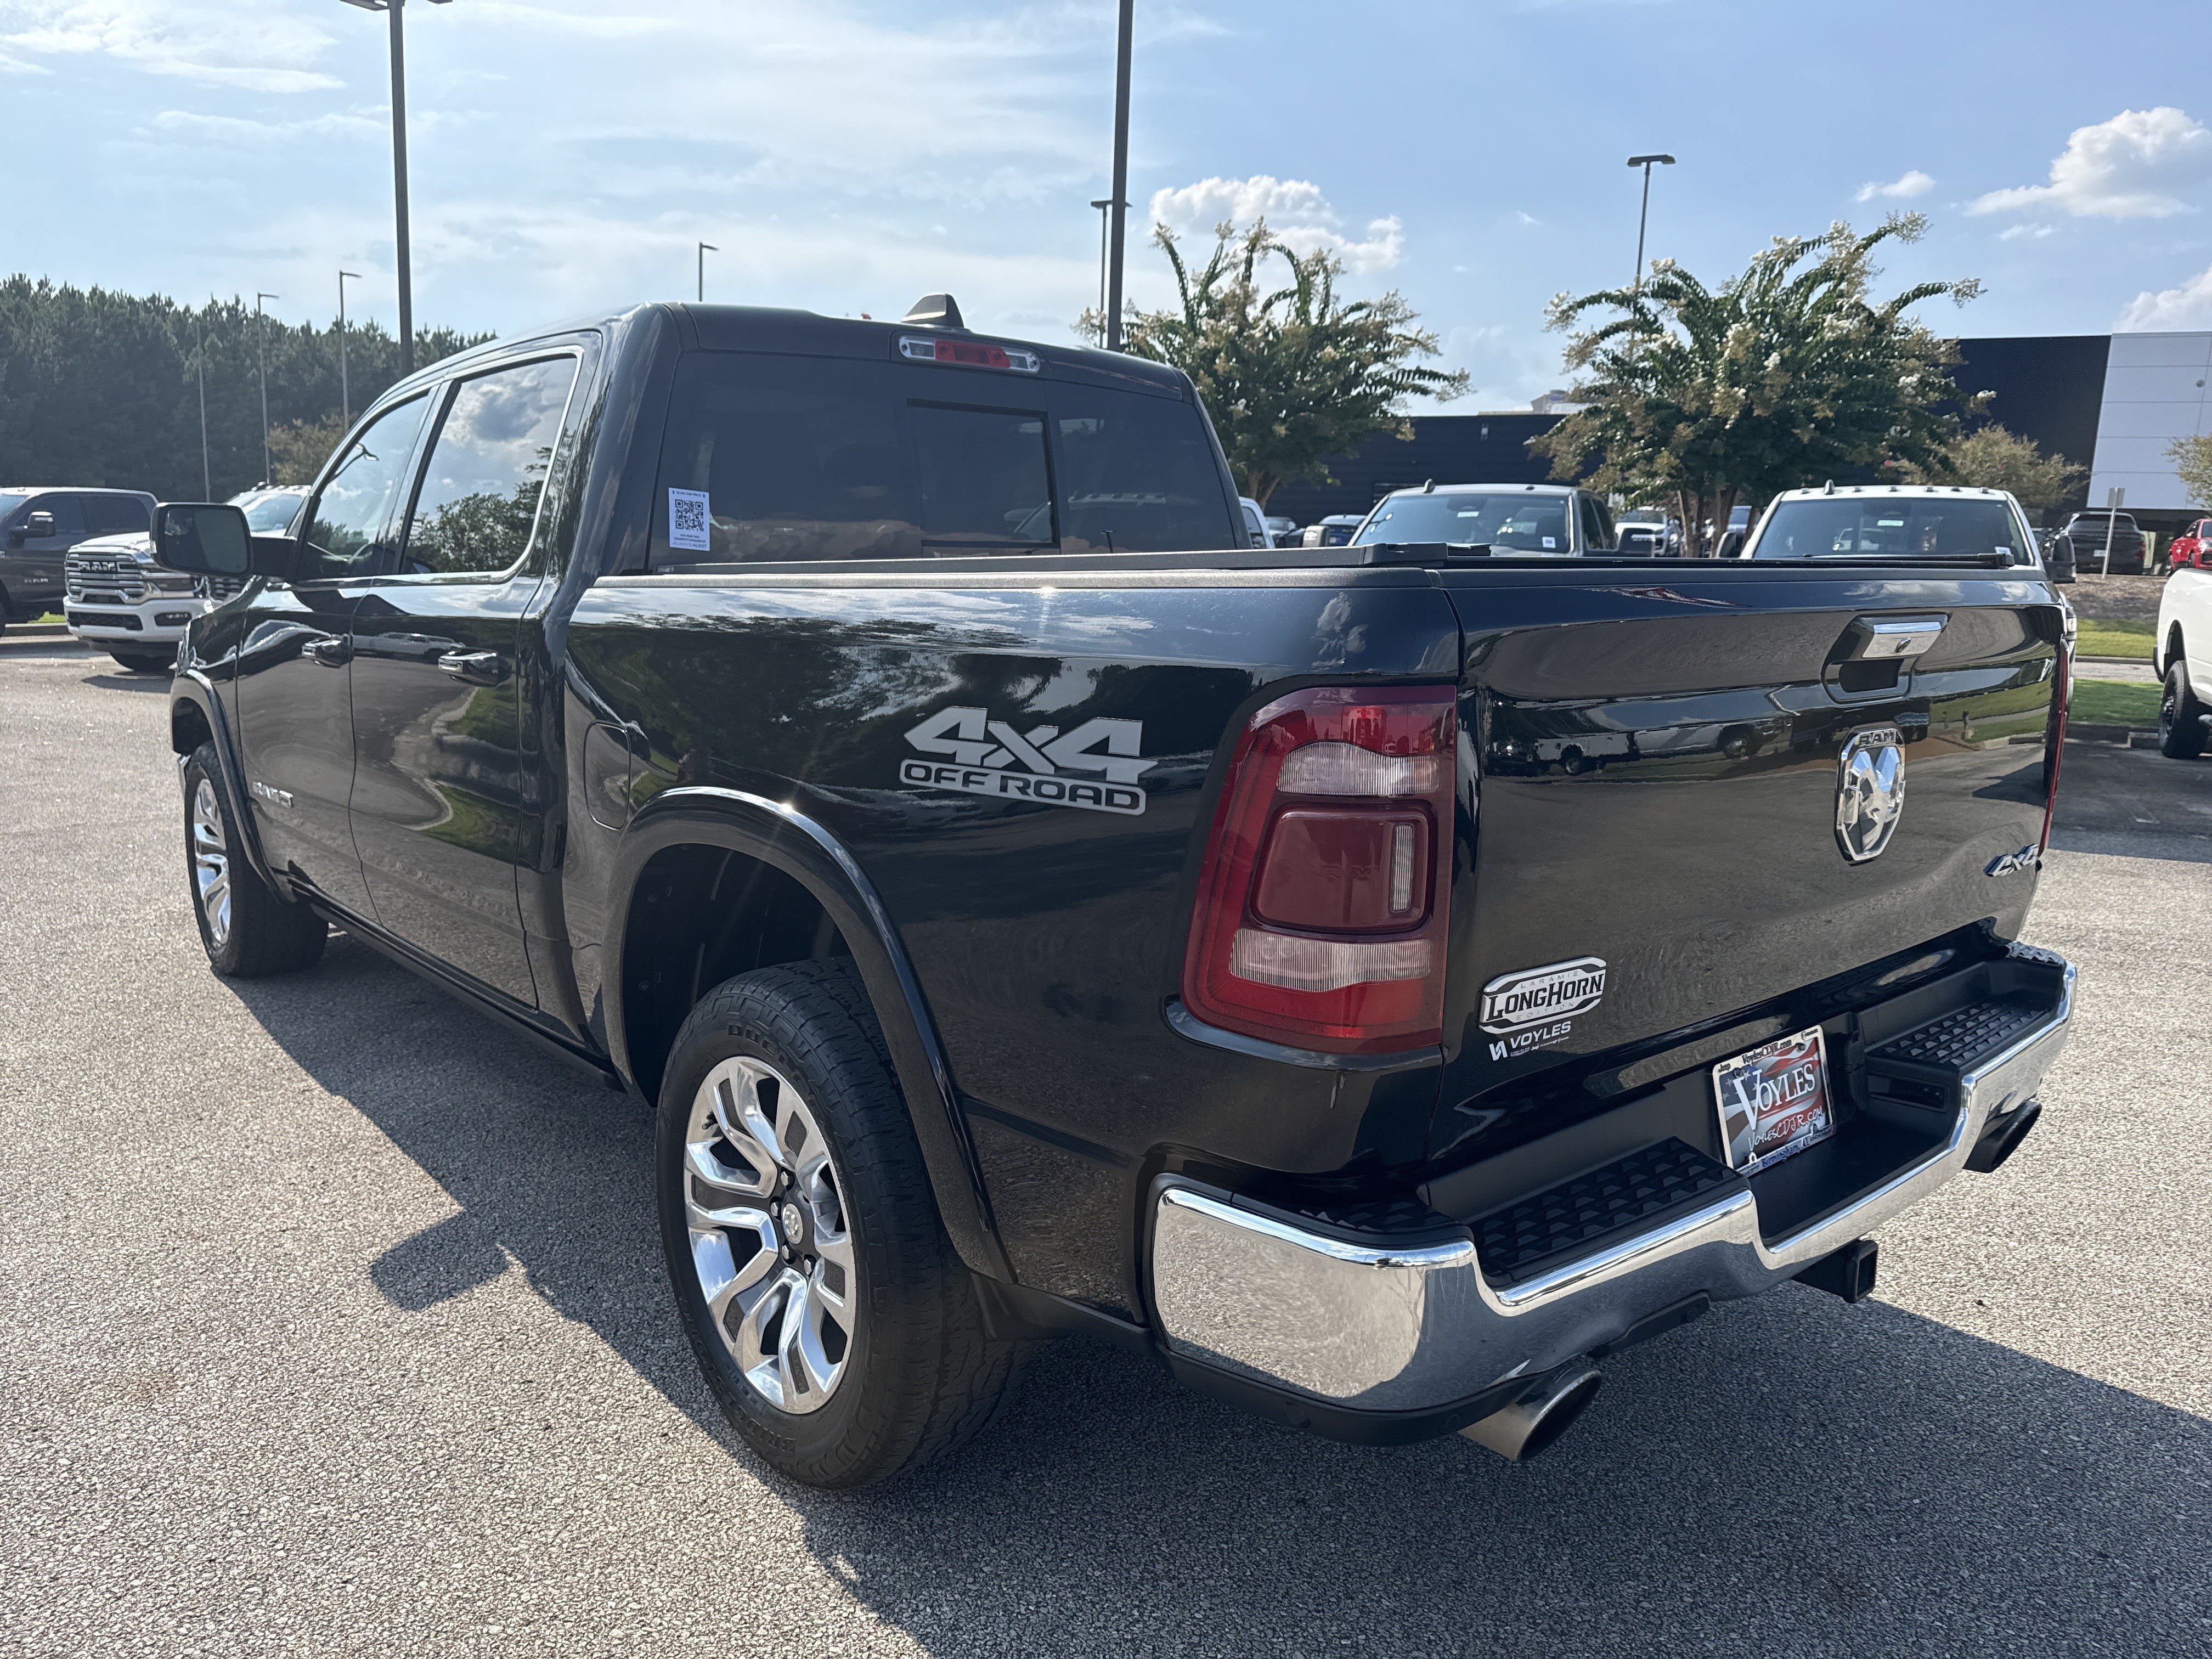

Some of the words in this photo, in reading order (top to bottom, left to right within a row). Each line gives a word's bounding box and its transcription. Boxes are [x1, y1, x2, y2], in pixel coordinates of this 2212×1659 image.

[78, 561, 116, 572] RAM
[1859, 729, 1897, 747] RAM
[904, 763, 990, 788] OFF
[999, 774, 1140, 810] ROAD
[1520, 970, 1579, 989] LARAMIE
[1486, 973, 1605, 1022] LONGHORN
[1516, 1002, 1575, 1021] EDITION
[1510, 1020, 1572, 1049] VOYLES
[1733, 1063, 1816, 1131] VOYLES
